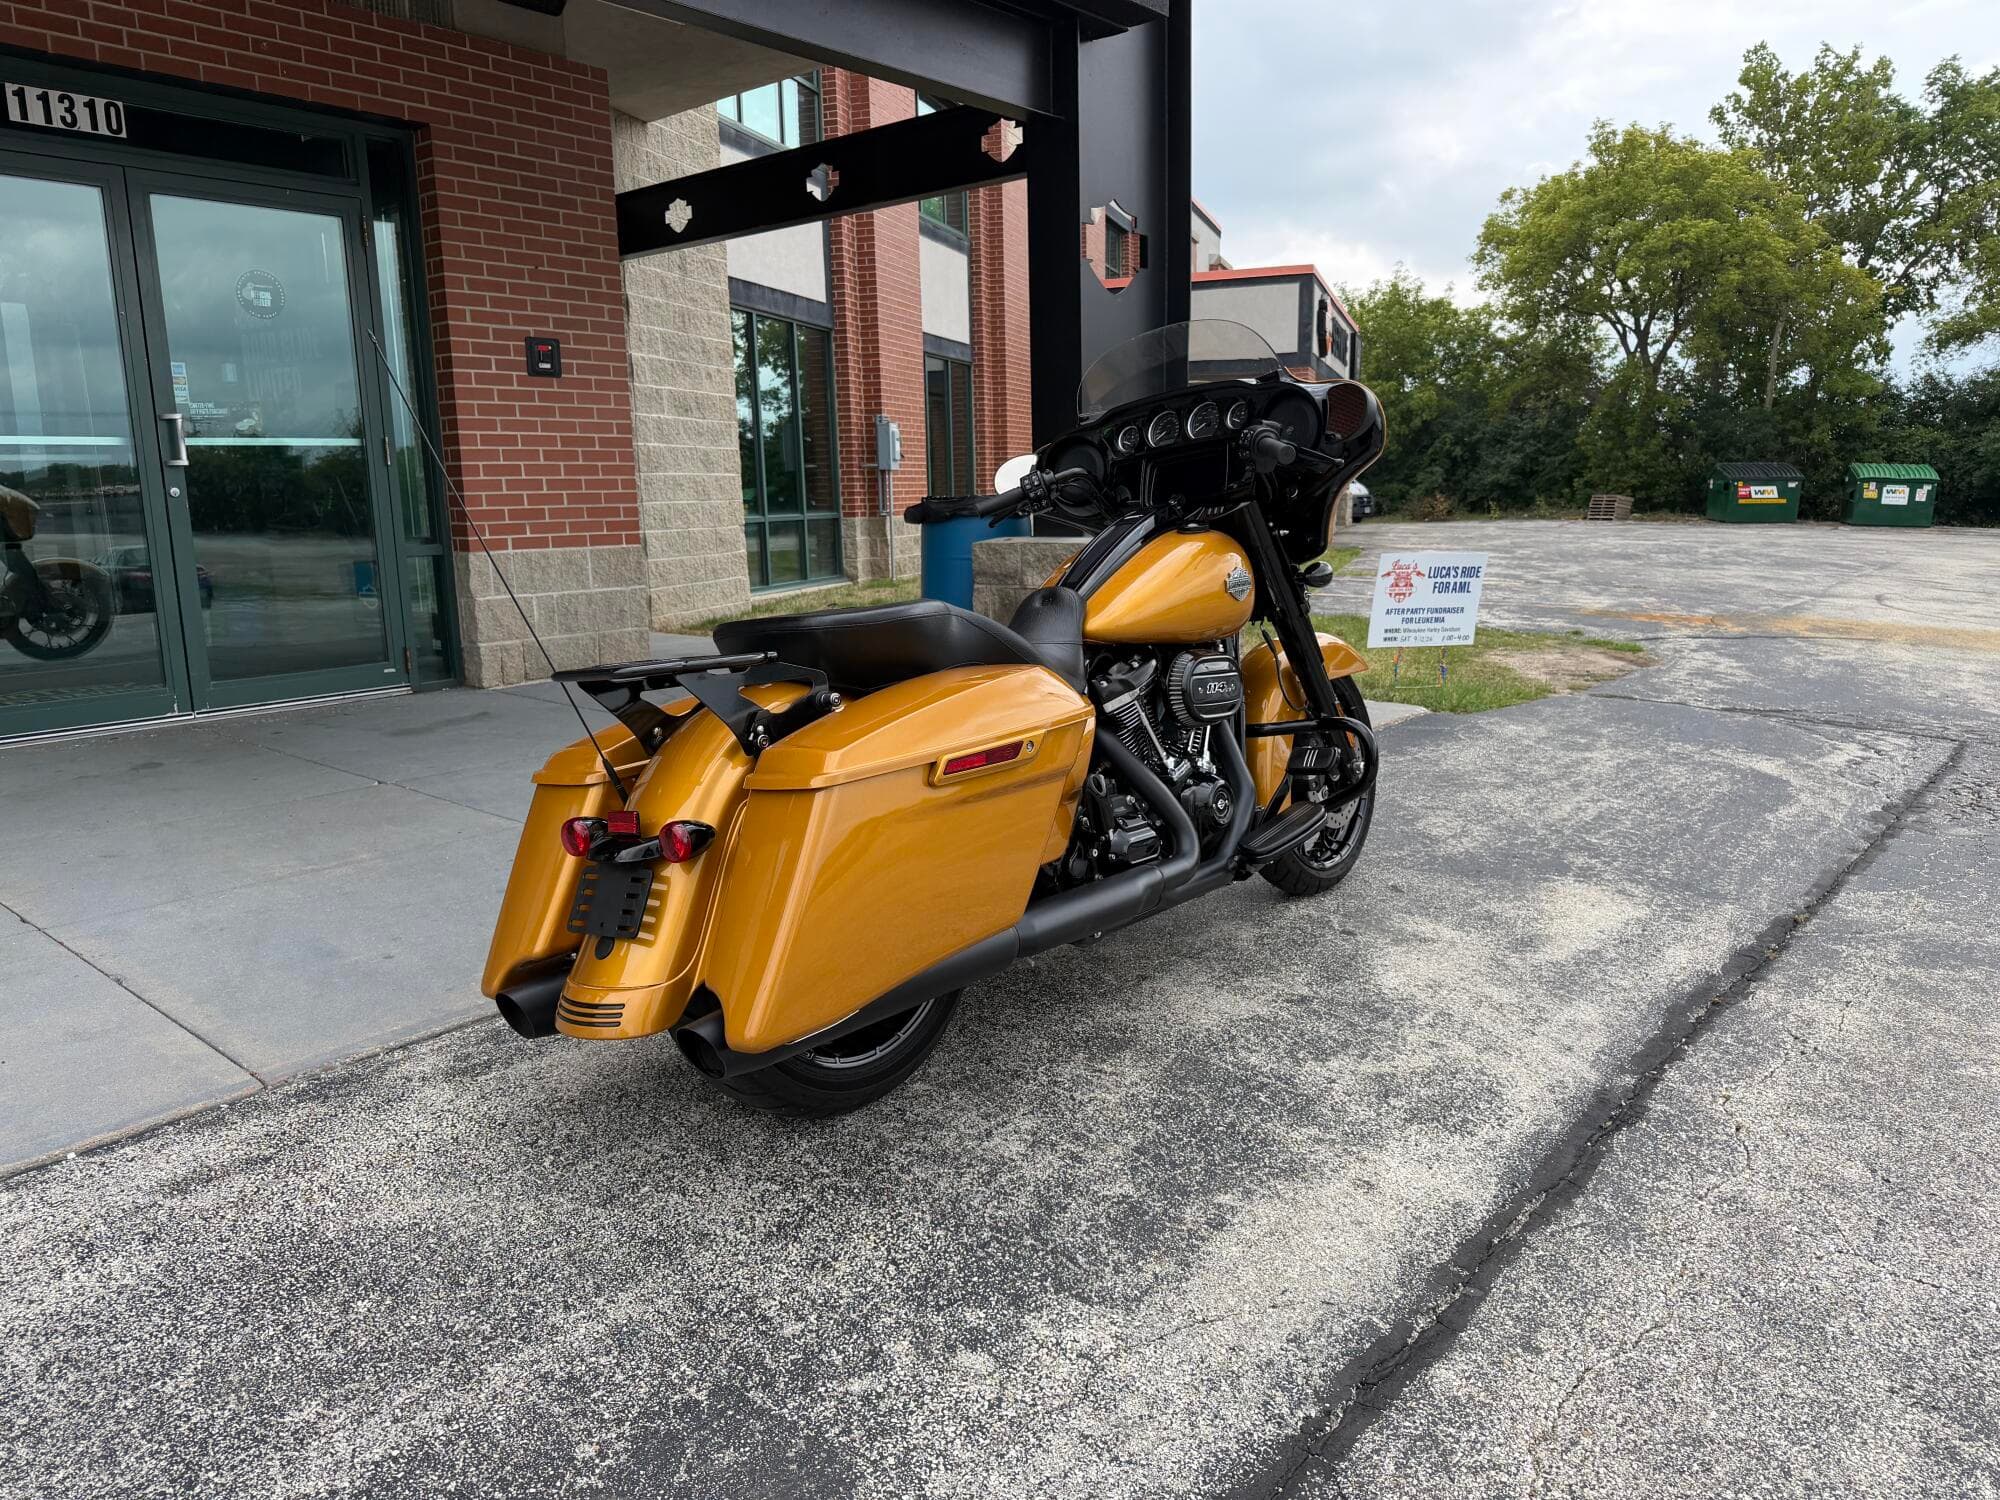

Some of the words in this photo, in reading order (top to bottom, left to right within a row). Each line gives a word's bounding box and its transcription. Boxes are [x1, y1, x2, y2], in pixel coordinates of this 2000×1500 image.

[12, 87, 123, 135] 11310
[1427, 566, 1460, 579] LUCA'S
[1460, 566, 1482, 579] RIDE
[1432, 582, 1451, 594] FOR
[1450, 581, 1472, 594] AML
[1385, 608, 1405, 616] AFTER
[1405, 607, 1426, 615] PARTY
[1426, 606, 1465, 615] FUNDRAISER
[1414, 616, 1445, 624] LEUKEMIA
